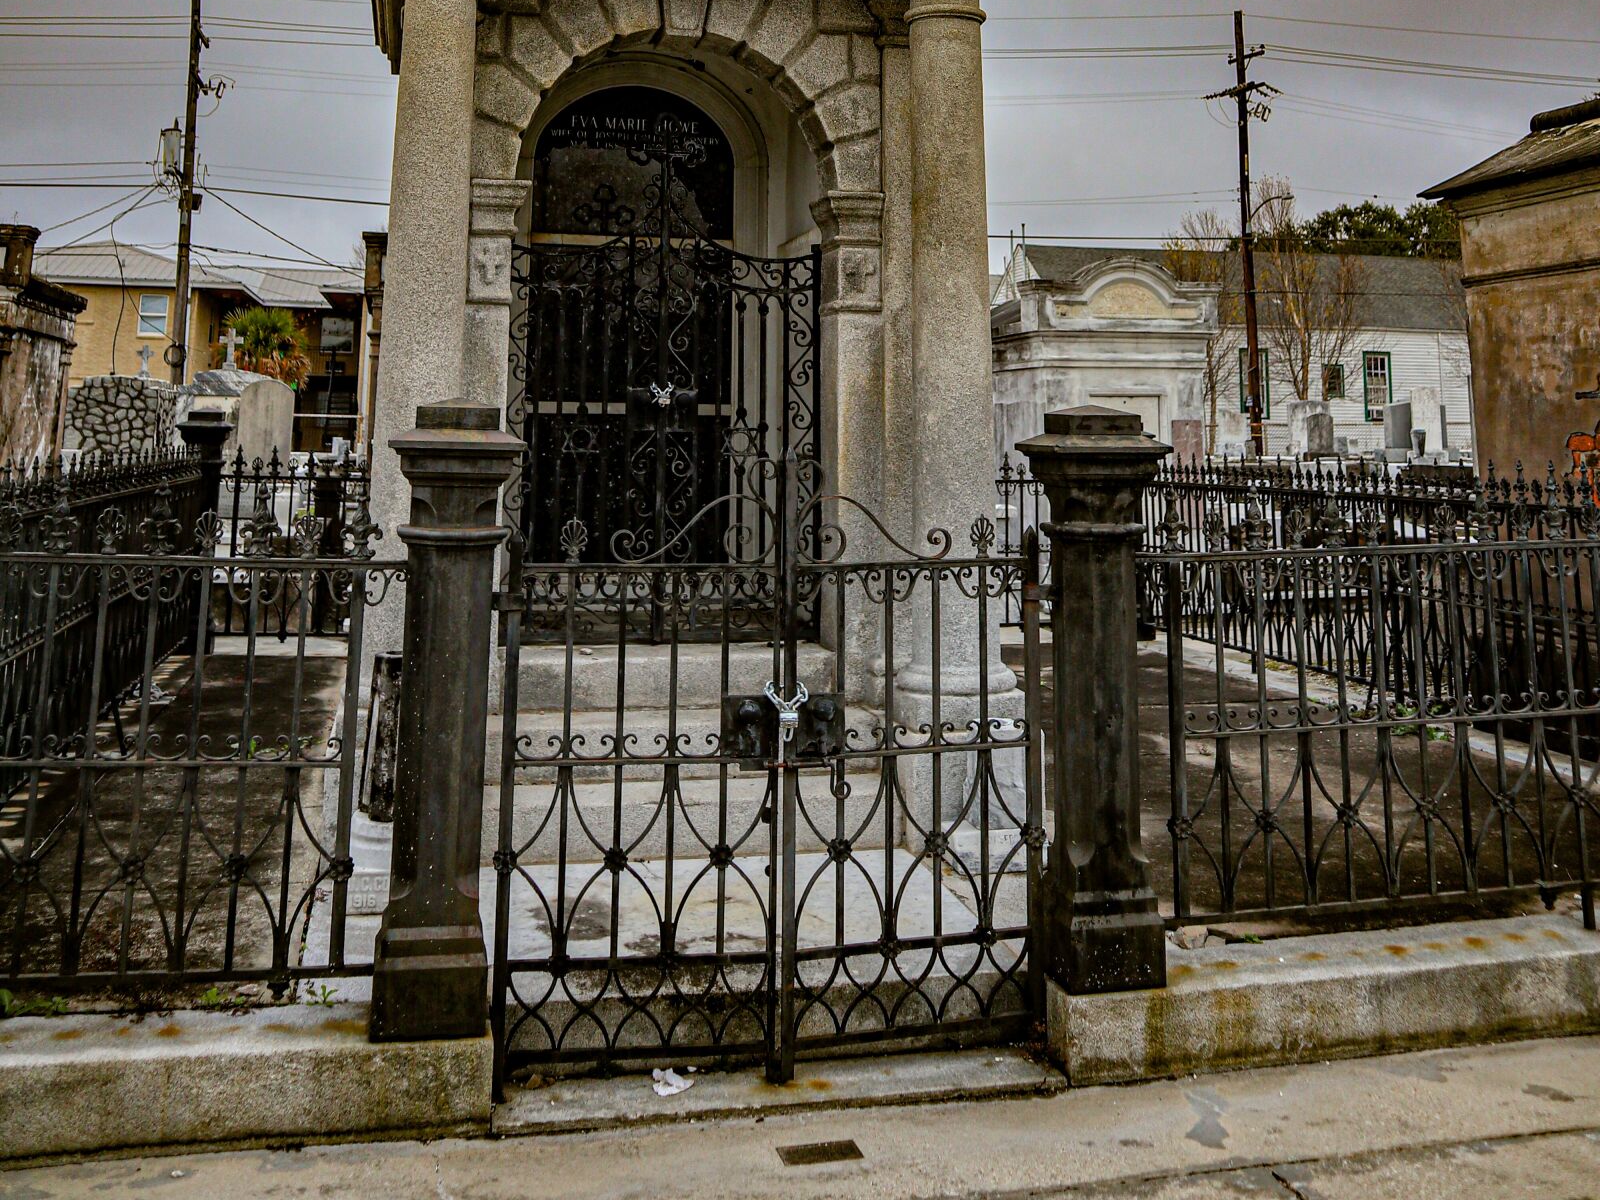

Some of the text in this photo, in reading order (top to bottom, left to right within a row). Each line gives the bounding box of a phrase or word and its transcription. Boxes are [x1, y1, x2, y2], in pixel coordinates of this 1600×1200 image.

[571, 114, 598, 129] EVA
[605, 116, 649, 132] MARIE
[550, 127, 573, 138] WIFE
